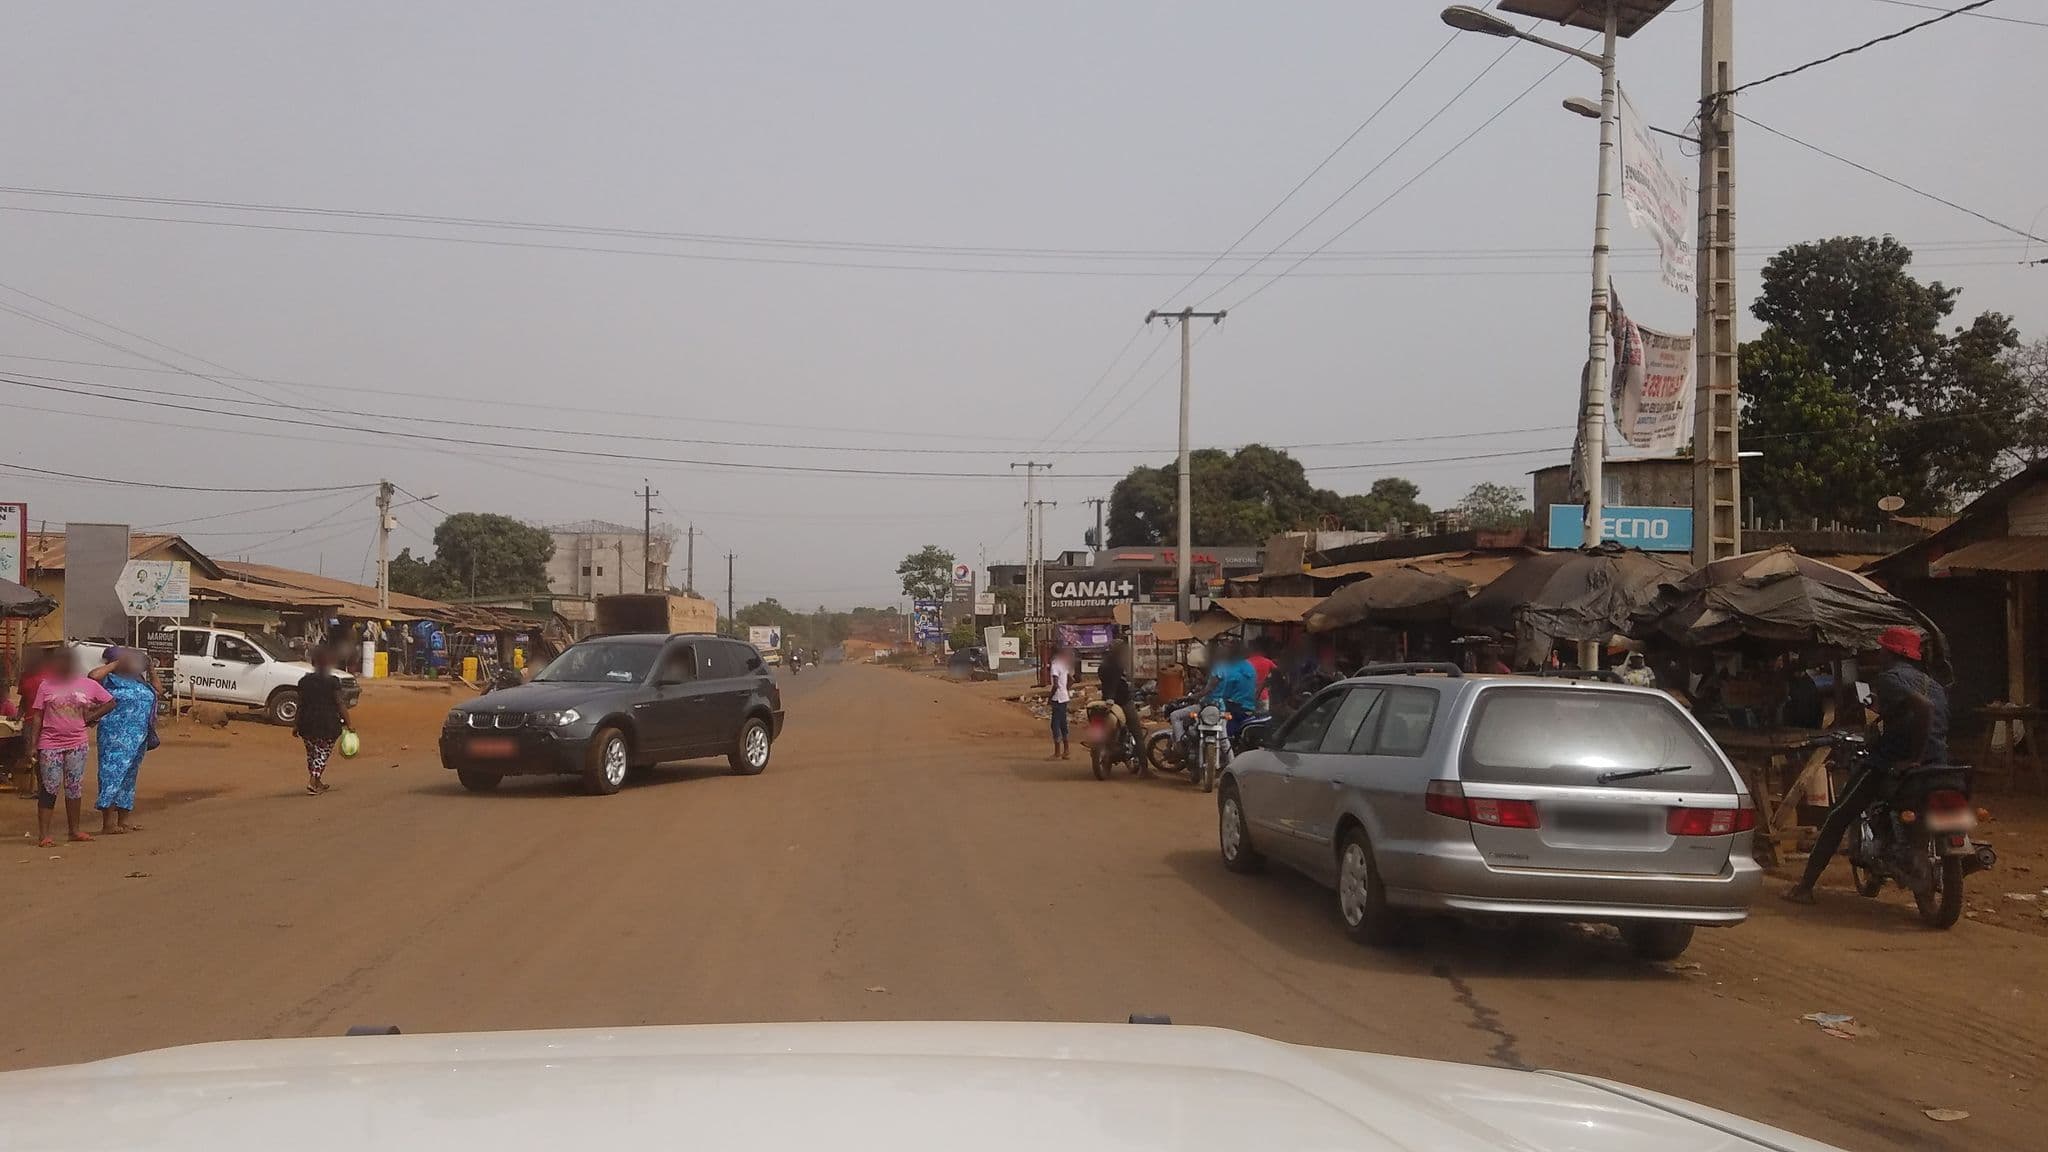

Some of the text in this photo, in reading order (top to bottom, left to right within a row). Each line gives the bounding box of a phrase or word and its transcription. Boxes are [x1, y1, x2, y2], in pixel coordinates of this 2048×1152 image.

[1598, 517, 1669, 539] ECNO
[1050, 580, 1134, 598] CANAL+
[1051, 599, 1106, 608] DISTRIBUTEUR
[189, 675, 237, 690] SONFONIA
